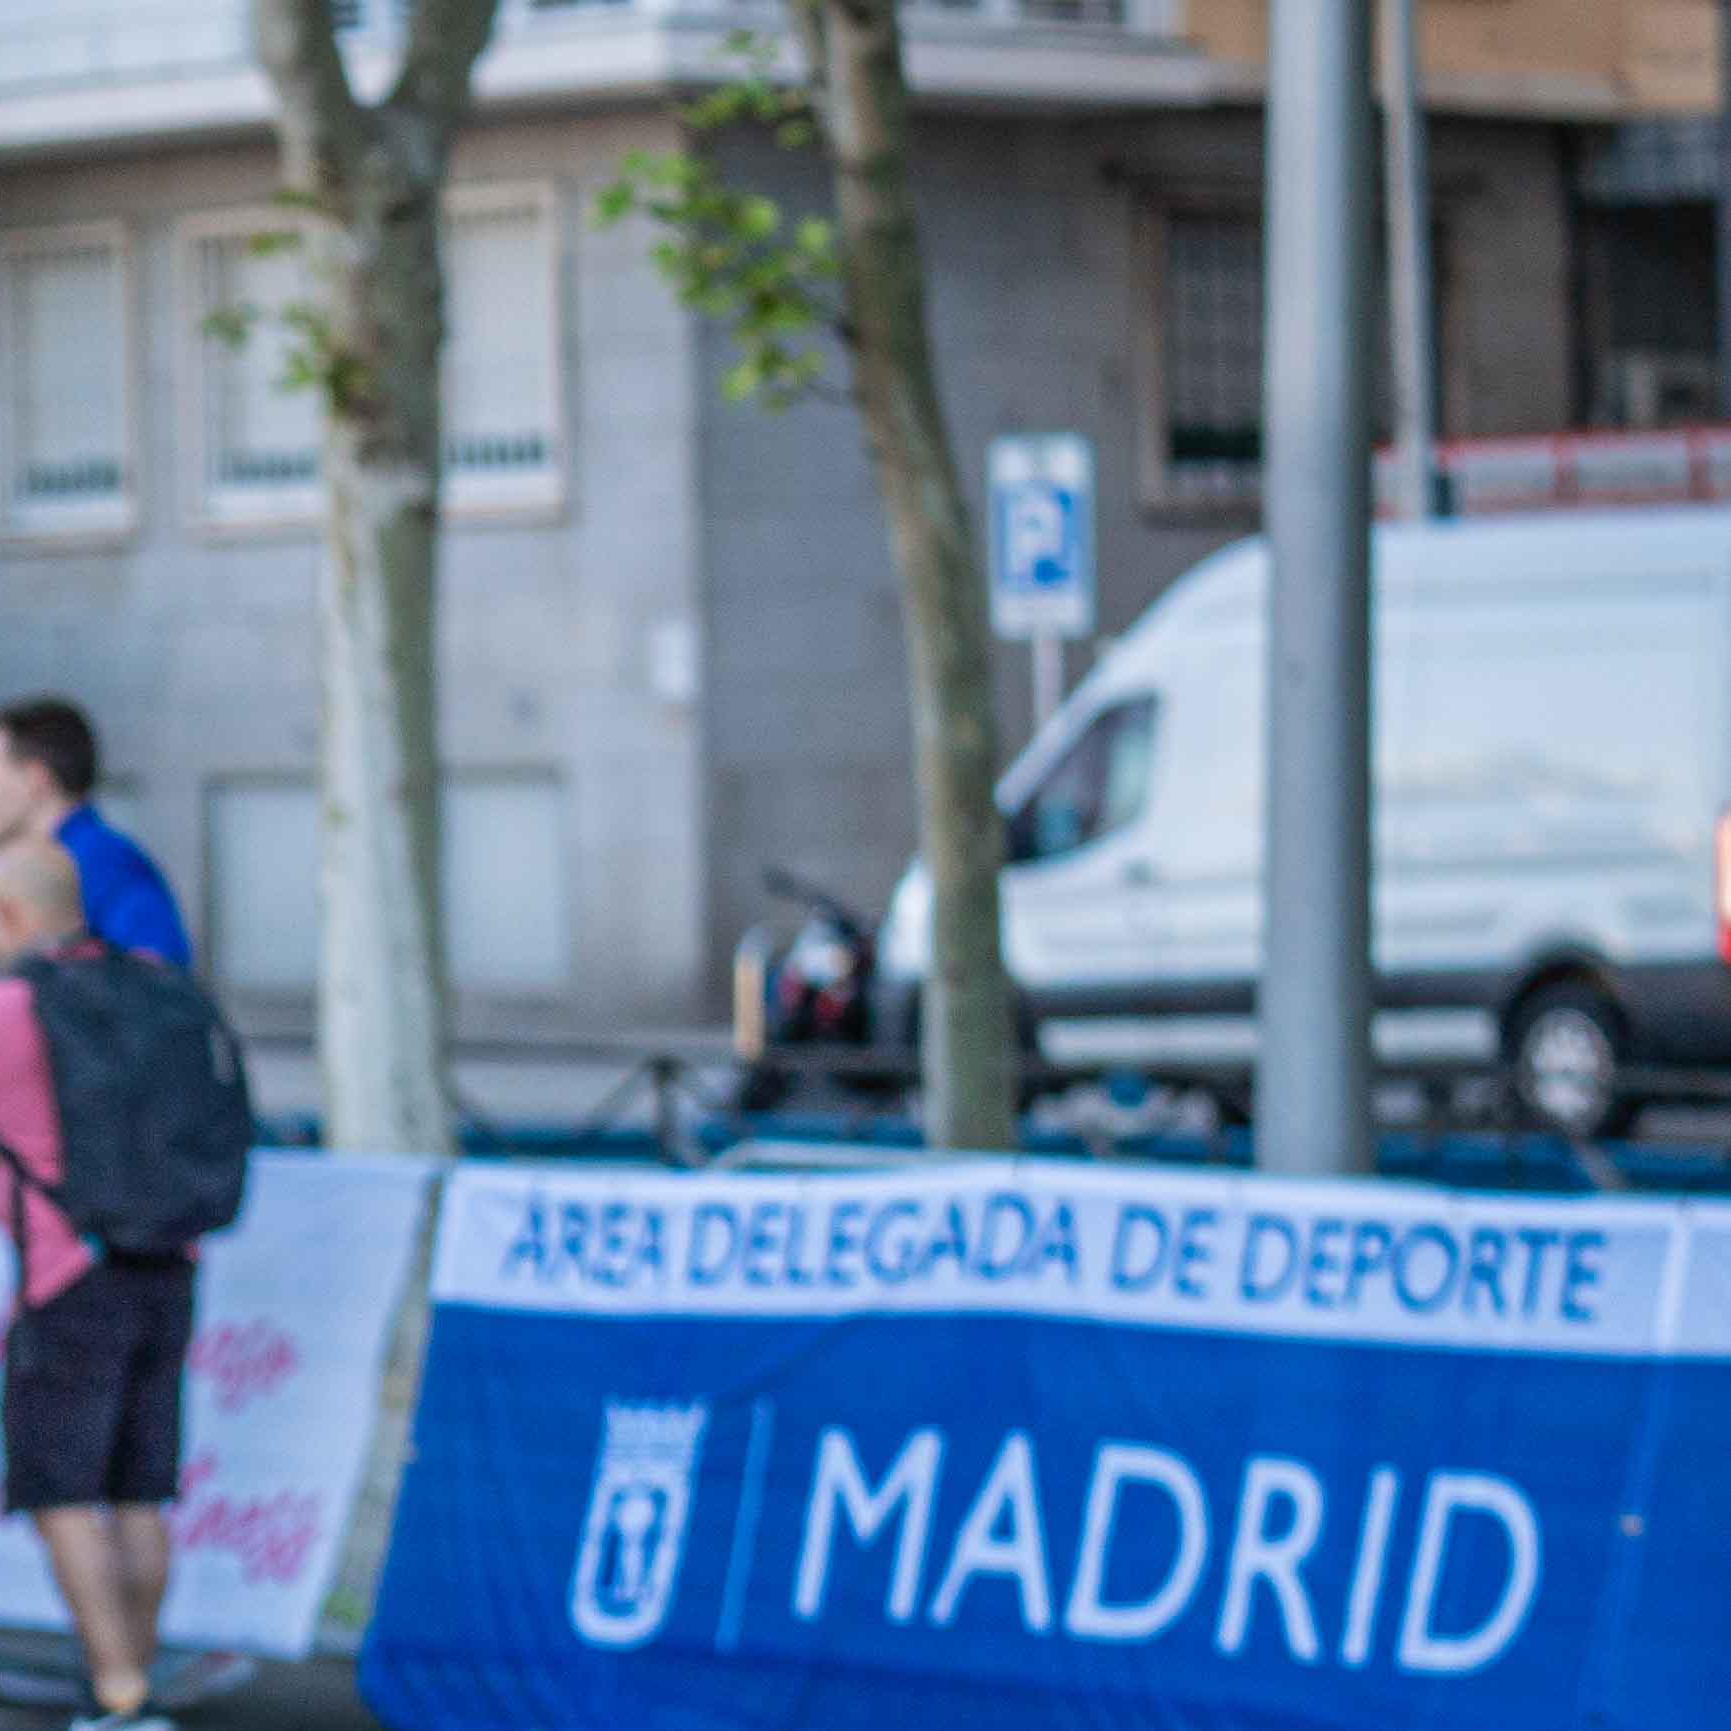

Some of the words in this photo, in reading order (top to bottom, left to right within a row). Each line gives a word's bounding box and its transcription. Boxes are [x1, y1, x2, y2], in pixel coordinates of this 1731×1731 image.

[686, 1191, 1081, 1289] DELEGADA
[1109, 1202, 1218, 1298] DE
[1240, 1210, 1608, 1323] DEPORTE
[790, 1425, 1542, 1676] MADRID
